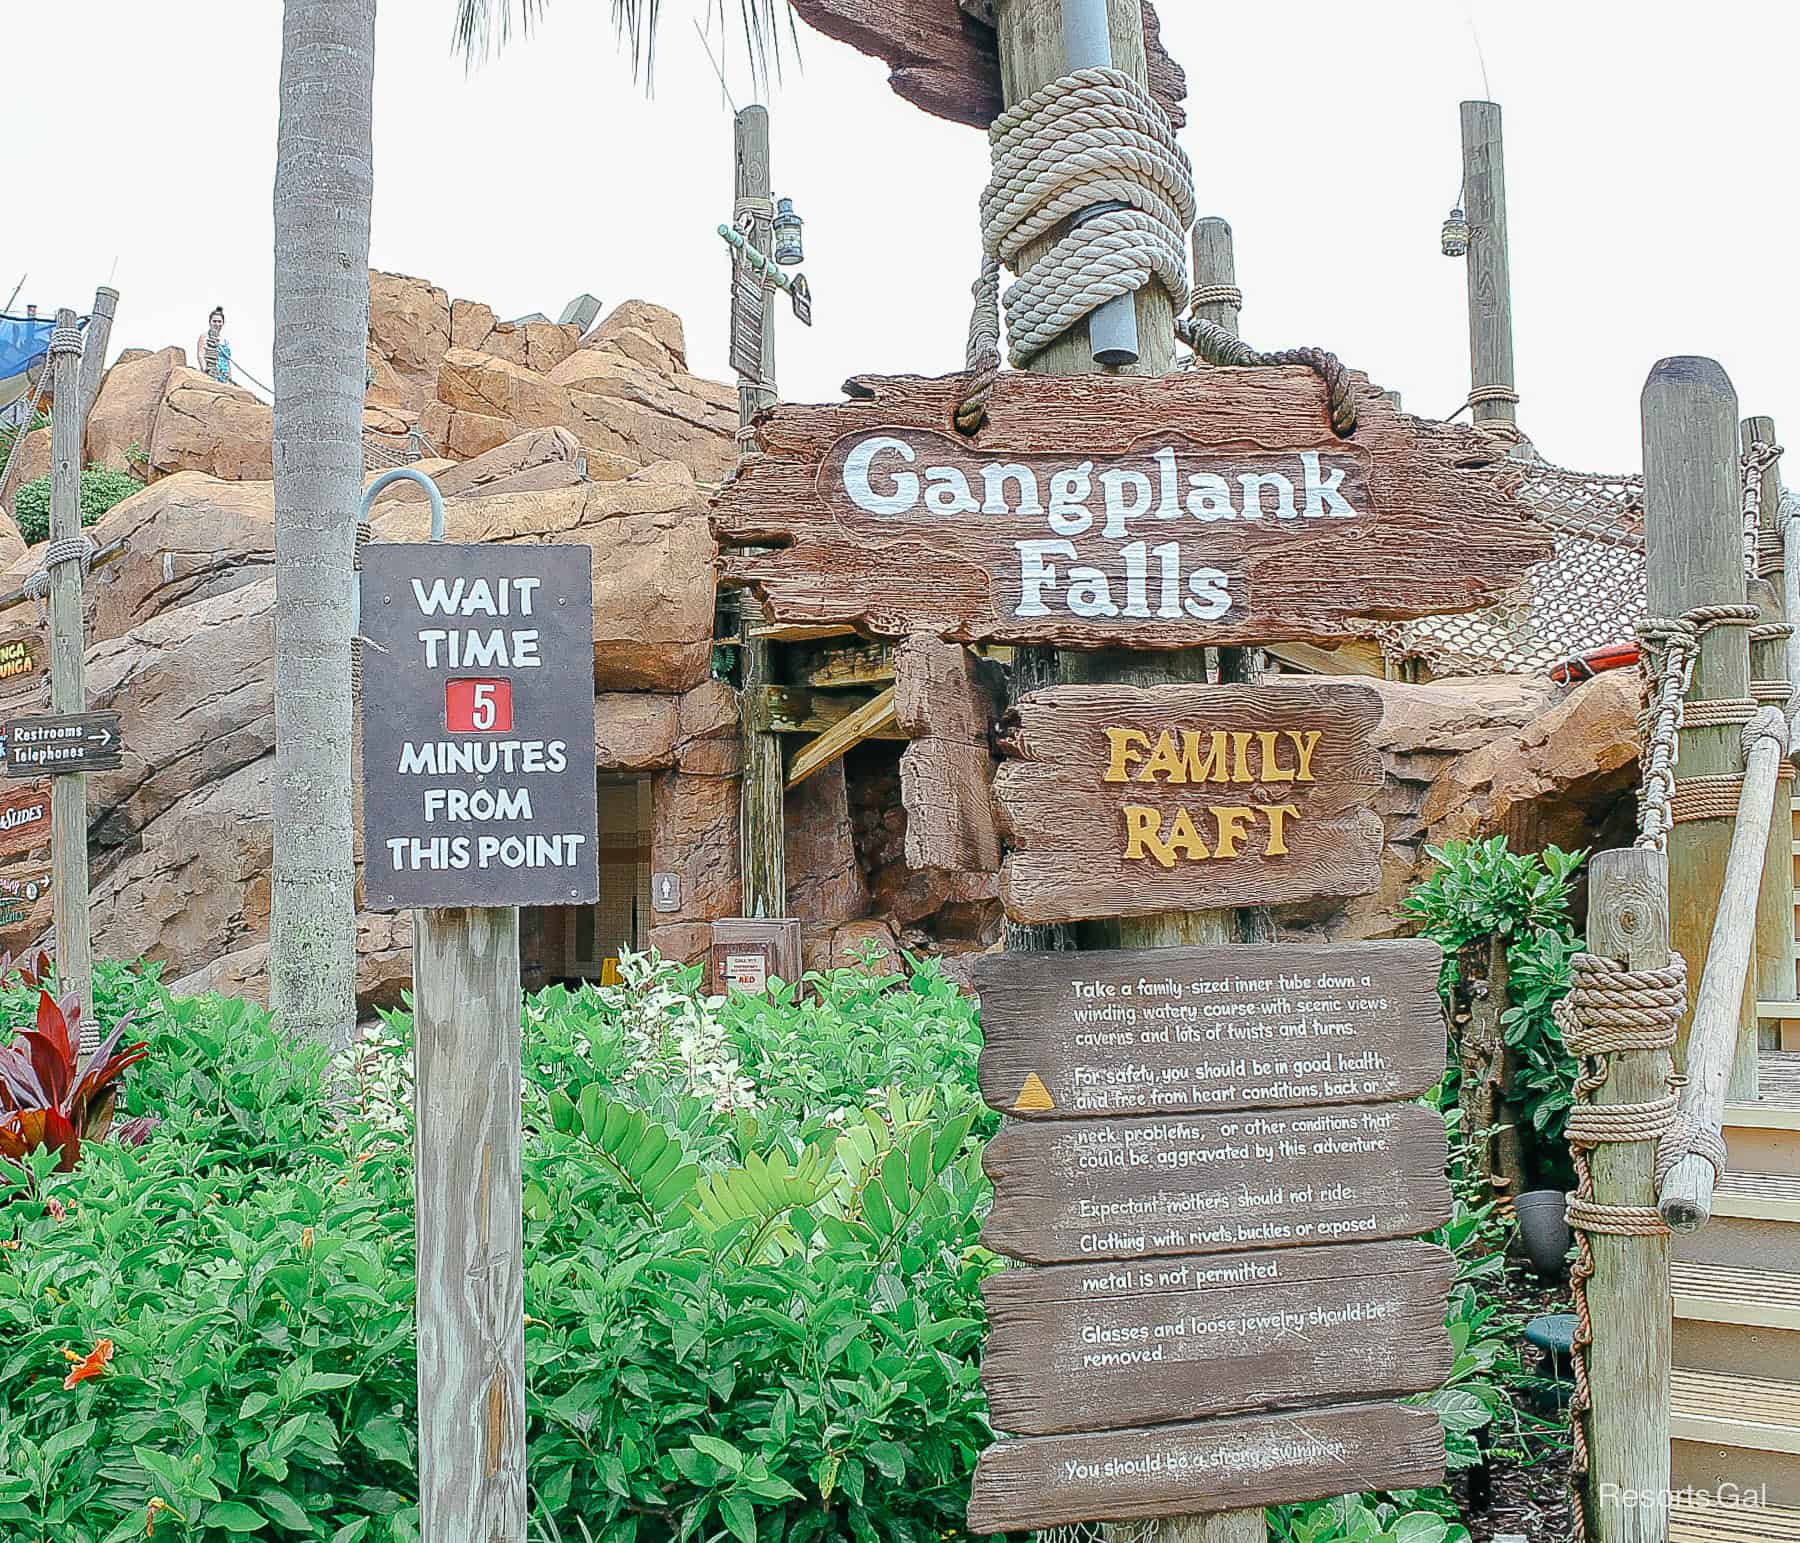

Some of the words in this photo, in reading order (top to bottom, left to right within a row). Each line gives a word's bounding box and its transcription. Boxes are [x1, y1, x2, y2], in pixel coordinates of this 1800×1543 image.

[842, 437, 1357, 538] Gangplank
[411, 577, 540, 616] WAIT
[1013, 540, 1232, 619] Falls
[418, 629, 542, 668] TIME
[472, 684, 496, 731] 5
[14, 727, 82, 742] Restrooms
[14, 745, 84, 765] Telephones
[398, 741, 567, 775] MINUTES
[1103, 727, 1322, 783] FAMILY
[424, 788, 533, 822] FROM
[386, 837, 470, 870] THIS
[478, 835, 585, 869] POINT
[1122, 805, 1300, 867] RAFT
[1072, 980, 1116, 998] Take
[1121, 985, 1132, 995] a
[1235, 975, 1273, 992] inner
[1278, 974, 1311, 991] tube
[1317, 973, 1355, 989] down
[1360, 975, 1371, 987] a
[1073, 1003, 1136, 1025] winding
[1143, 1003, 1197, 1021] watery
[1203, 1003, 1255, 1017] course
[1261, 997, 1291, 1015] with
[1297, 995, 1342, 1012] scenic
[1076, 1032, 1134, 1046] caverns
[1140, 1027, 1169, 1043] and
[1175, 1025, 1200, 1042] lots
[1206, 1023, 1222, 1040] of
[1227, 1021, 1273, 1039] twists
[1279, 1018, 1307, 1036] and
[1312, 1019, 1357, 1036] turns.
[1074, 1067, 1099, 1086] For
[1196, 1059, 1246, 1080] should
[1253, 1060, 1272, 1075] be
[1275, 1059, 1288, 1074] in
[1294, 1052, 1331, 1077] good
[1338, 1051, 1385, 1071] health
[1076, 1093, 1108, 1110] and
[1115, 1092, 1146, 1107] free
[1151, 1089, 1187, 1104] from
[1193, 1085, 1235, 1102] heart
[1363, 1081, 1379, 1094] or
[1077, 1126, 1116, 1144] neck
[1125, 1124, 1206, 1147] problems,
[1220, 1123, 1238, 1136] or
[1245, 1119, 1286, 1135] other
[1292, 1115, 1358, 1132] conditions
[1363, 1113, 1393, 1130] that
[1079, 1150, 1125, 1168] could
[1129, 1150, 1149, 1166] be
[1157, 1143, 1249, 1168] aggravated
[1255, 1143, 1273, 1163] by
[1279, 1140, 1307, 1156] this
[1313, 1137, 1390, 1154] adventure.
[1079, 1196, 1158, 1223] Expectant
[1167, 1194, 1229, 1213] mothers
[1238, 1189, 1283, 1207] should
[1290, 1184, 1313, 1203] not
[1080, 1232, 1145, 1252] Clothing
[1152, 1230, 1185, 1247] with
[1295, 1224, 1313, 1236] or
[1318, 1215, 1377, 1238] exposed
[1082, 1271, 1132, 1291] metal
[1139, 1269, 1153, 1287] is
[1159, 1266, 1189, 1285] not
[1196, 1260, 1283, 1289] permitted.
[1081, 1325, 1149, 1344] Glasses
[1154, 1319, 1185, 1338] and
[1191, 1317, 1236, 1334] loose
[1239, 1310, 1304, 1335] jewelry
[1310, 1302, 1361, 1324] should
[1083, 1344, 1167, 1368] removed.
[1065, 1460, 1099, 1480] You
[1104, 1454, 1160, 1476] should
